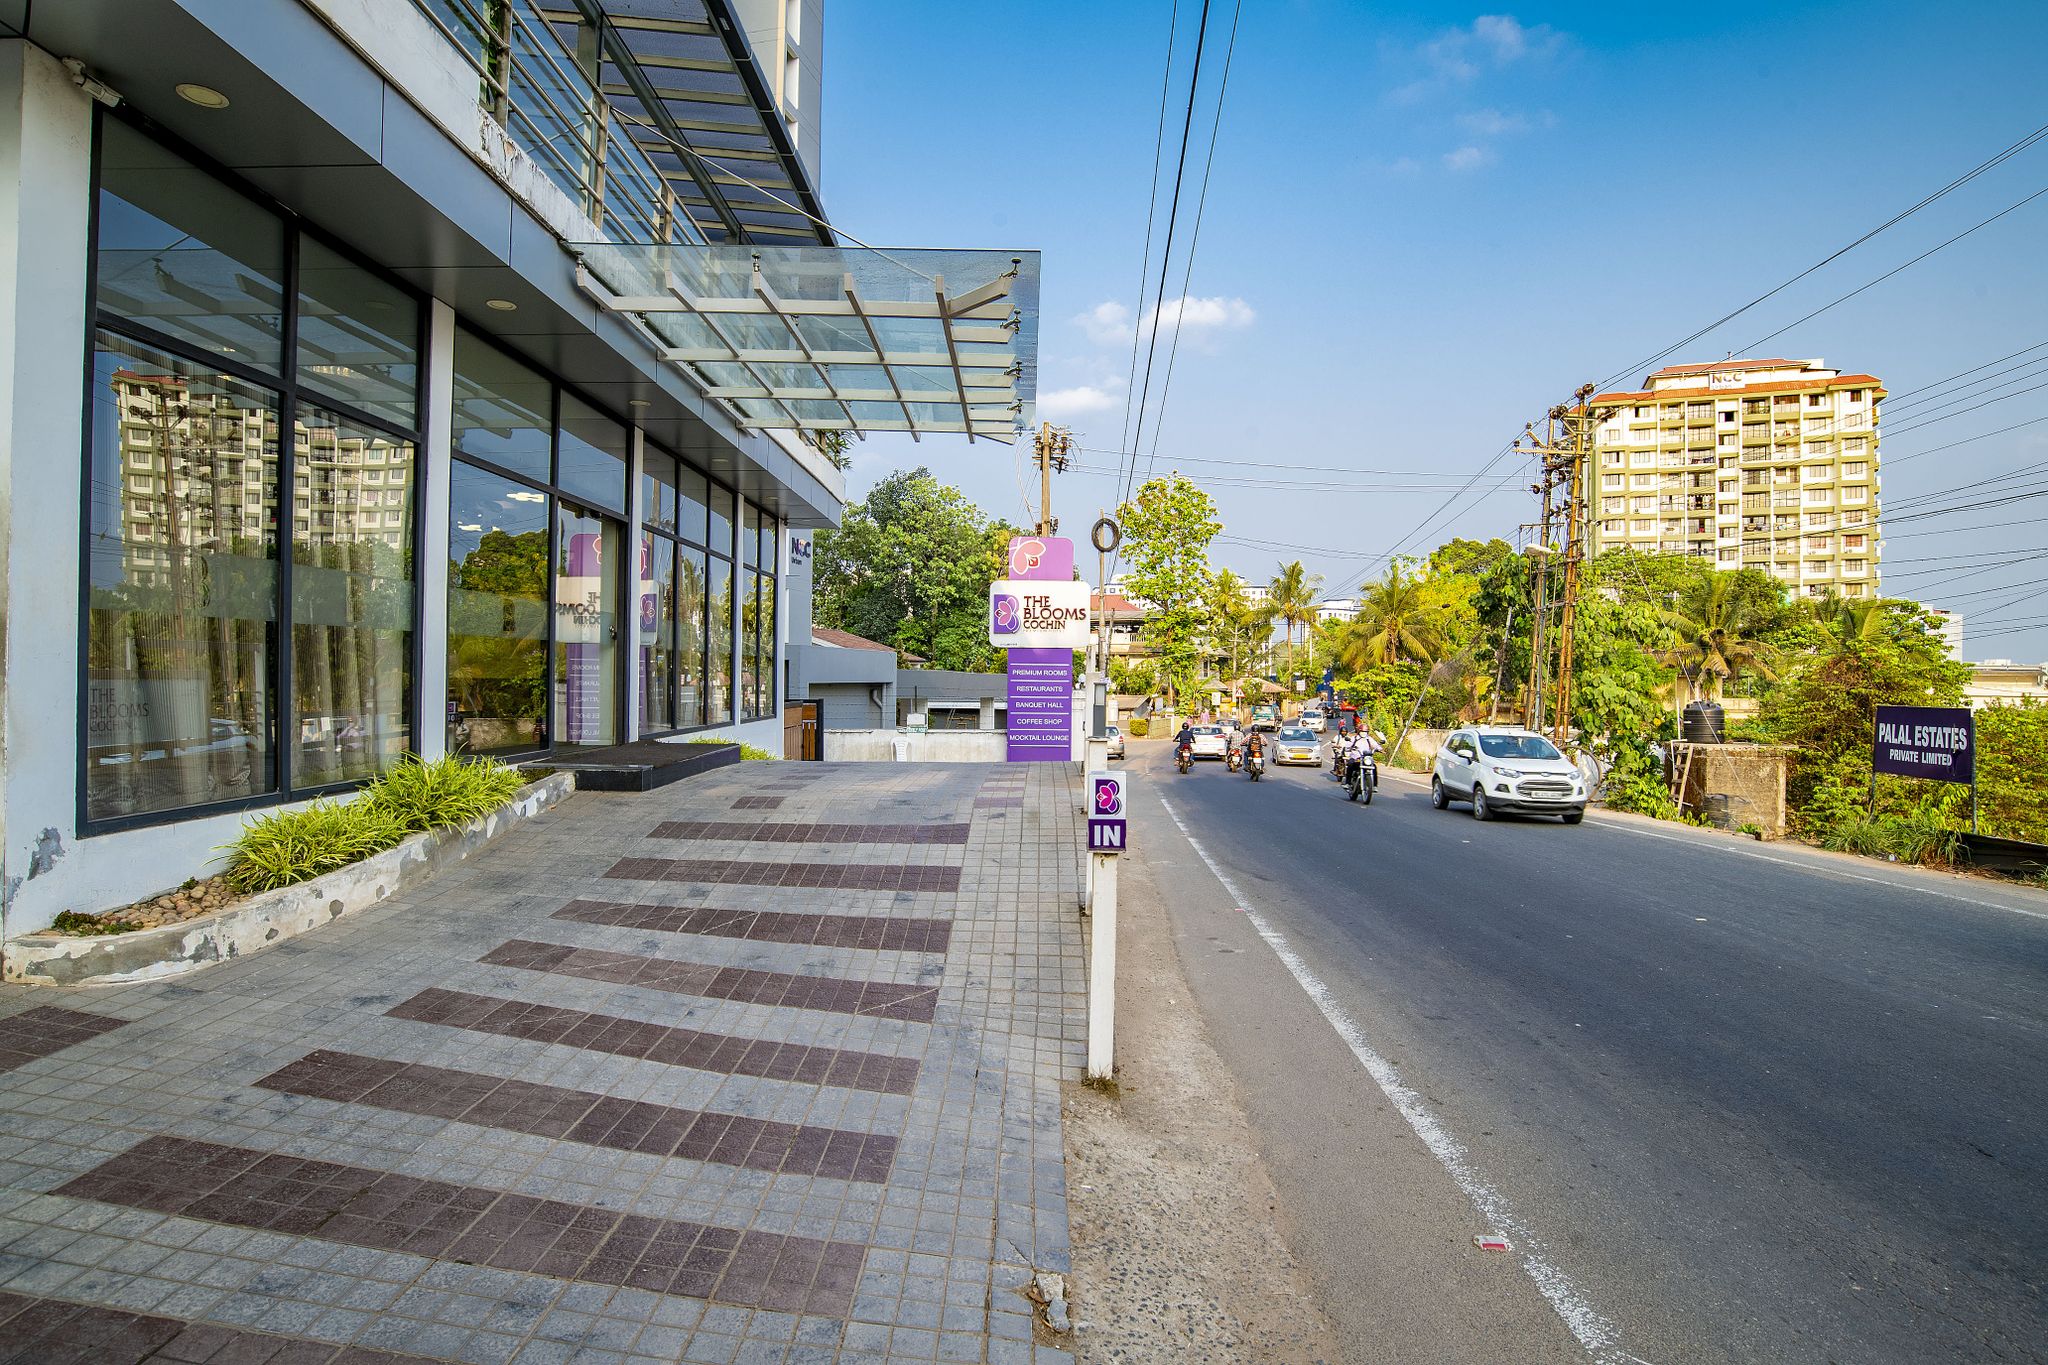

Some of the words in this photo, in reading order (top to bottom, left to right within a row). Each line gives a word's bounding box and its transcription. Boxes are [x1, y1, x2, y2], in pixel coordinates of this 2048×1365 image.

[1712, 373, 1742, 383] NCC
[1023, 596, 1051, 607] THE
[1023, 608, 1087, 620] BLOOMS
[1023, 620, 1066, 629] COCHIN
[1043, 669, 1068, 677] ROOMS
[1879, 723, 1911, 745] PALAL
[1914, 725, 1968, 751] ESTATES
[1889, 749, 1919, 763] PRIVATE
[1921, 751, 1953, 767] LIMITED
[1094, 825, 1121, 846] IN
